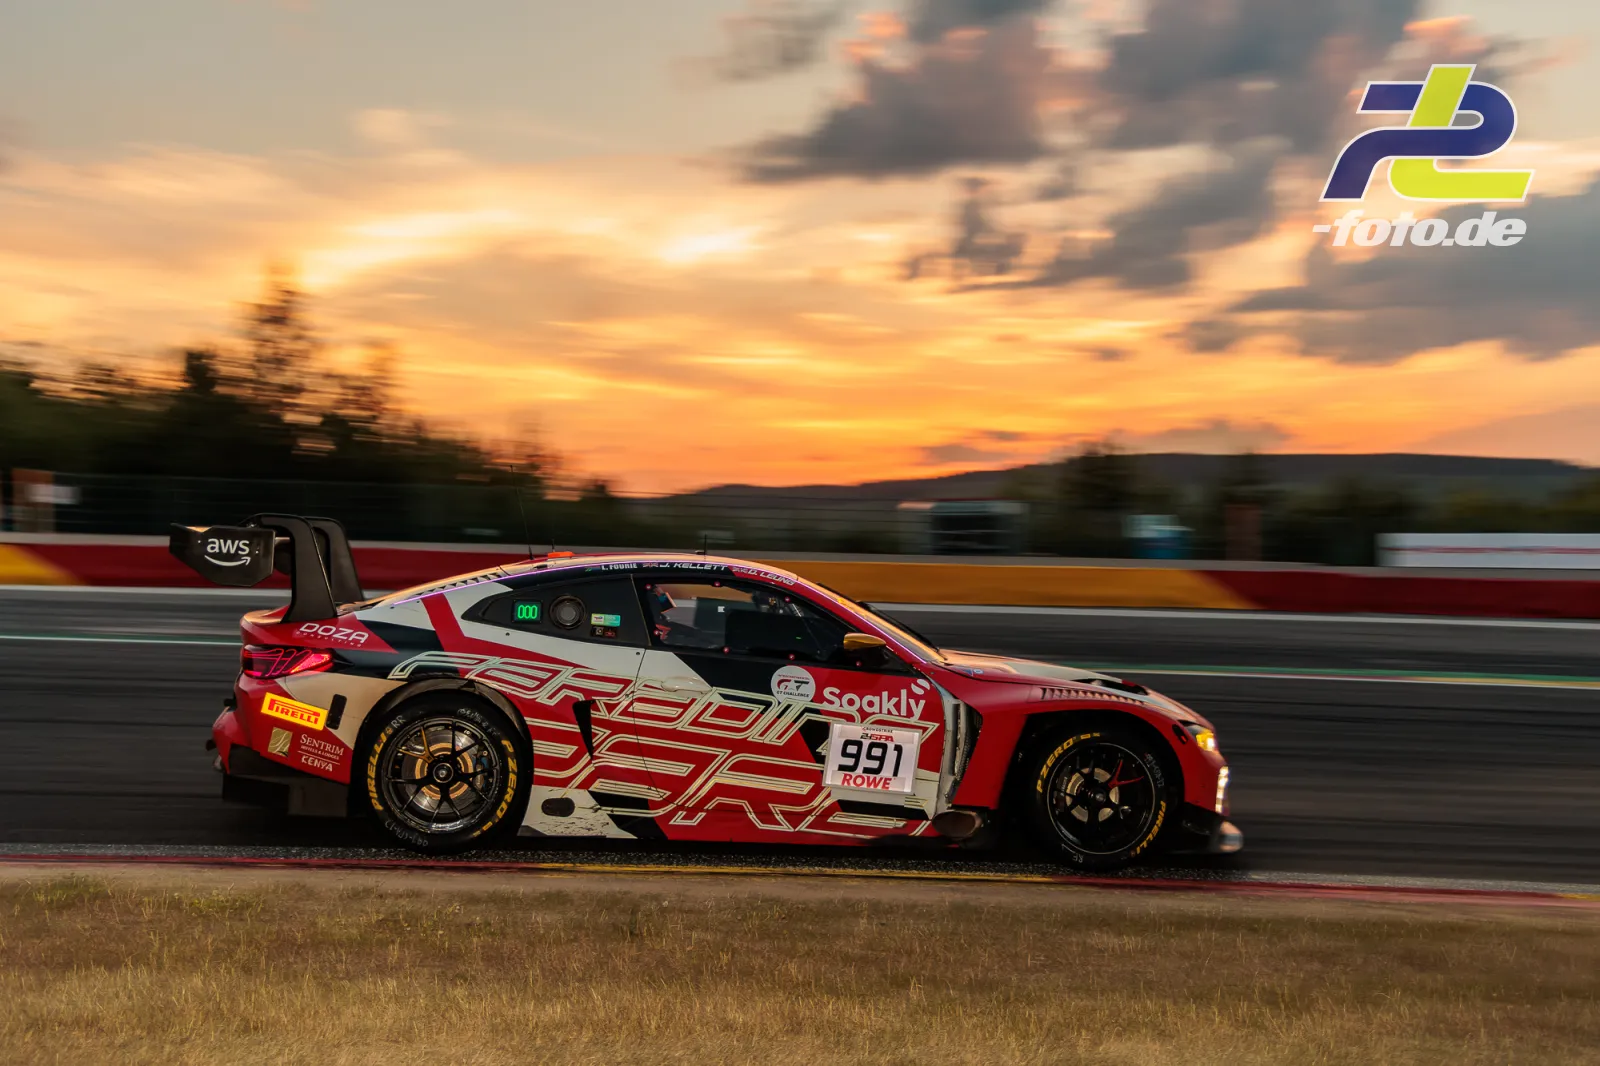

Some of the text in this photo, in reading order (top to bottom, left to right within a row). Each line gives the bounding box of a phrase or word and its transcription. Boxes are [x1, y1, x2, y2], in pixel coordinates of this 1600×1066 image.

[206, 538, 250, 555] aws
[670, 562, 729, 571] KELLETT
[748, 567, 796, 586] D. LEUNG
[517, 604, 538, 620] 000
[299, 622, 369, 644] DOZA
[267, 698, 321, 725] PIRELLI
[823, 686, 926, 721] Soakly
[299, 733, 345, 756] SENTRIM
[301, 755, 333, 772] KENYA
[837, 738, 903, 777] 991
[1040, 738, 1074, 780] ZERO
[367, 733, 389, 811] PIRELLI
[841, 772, 892, 791] ROWE
[496, 757, 518, 819] ZERO
[1136, 800, 1167, 854] PIRELLI
